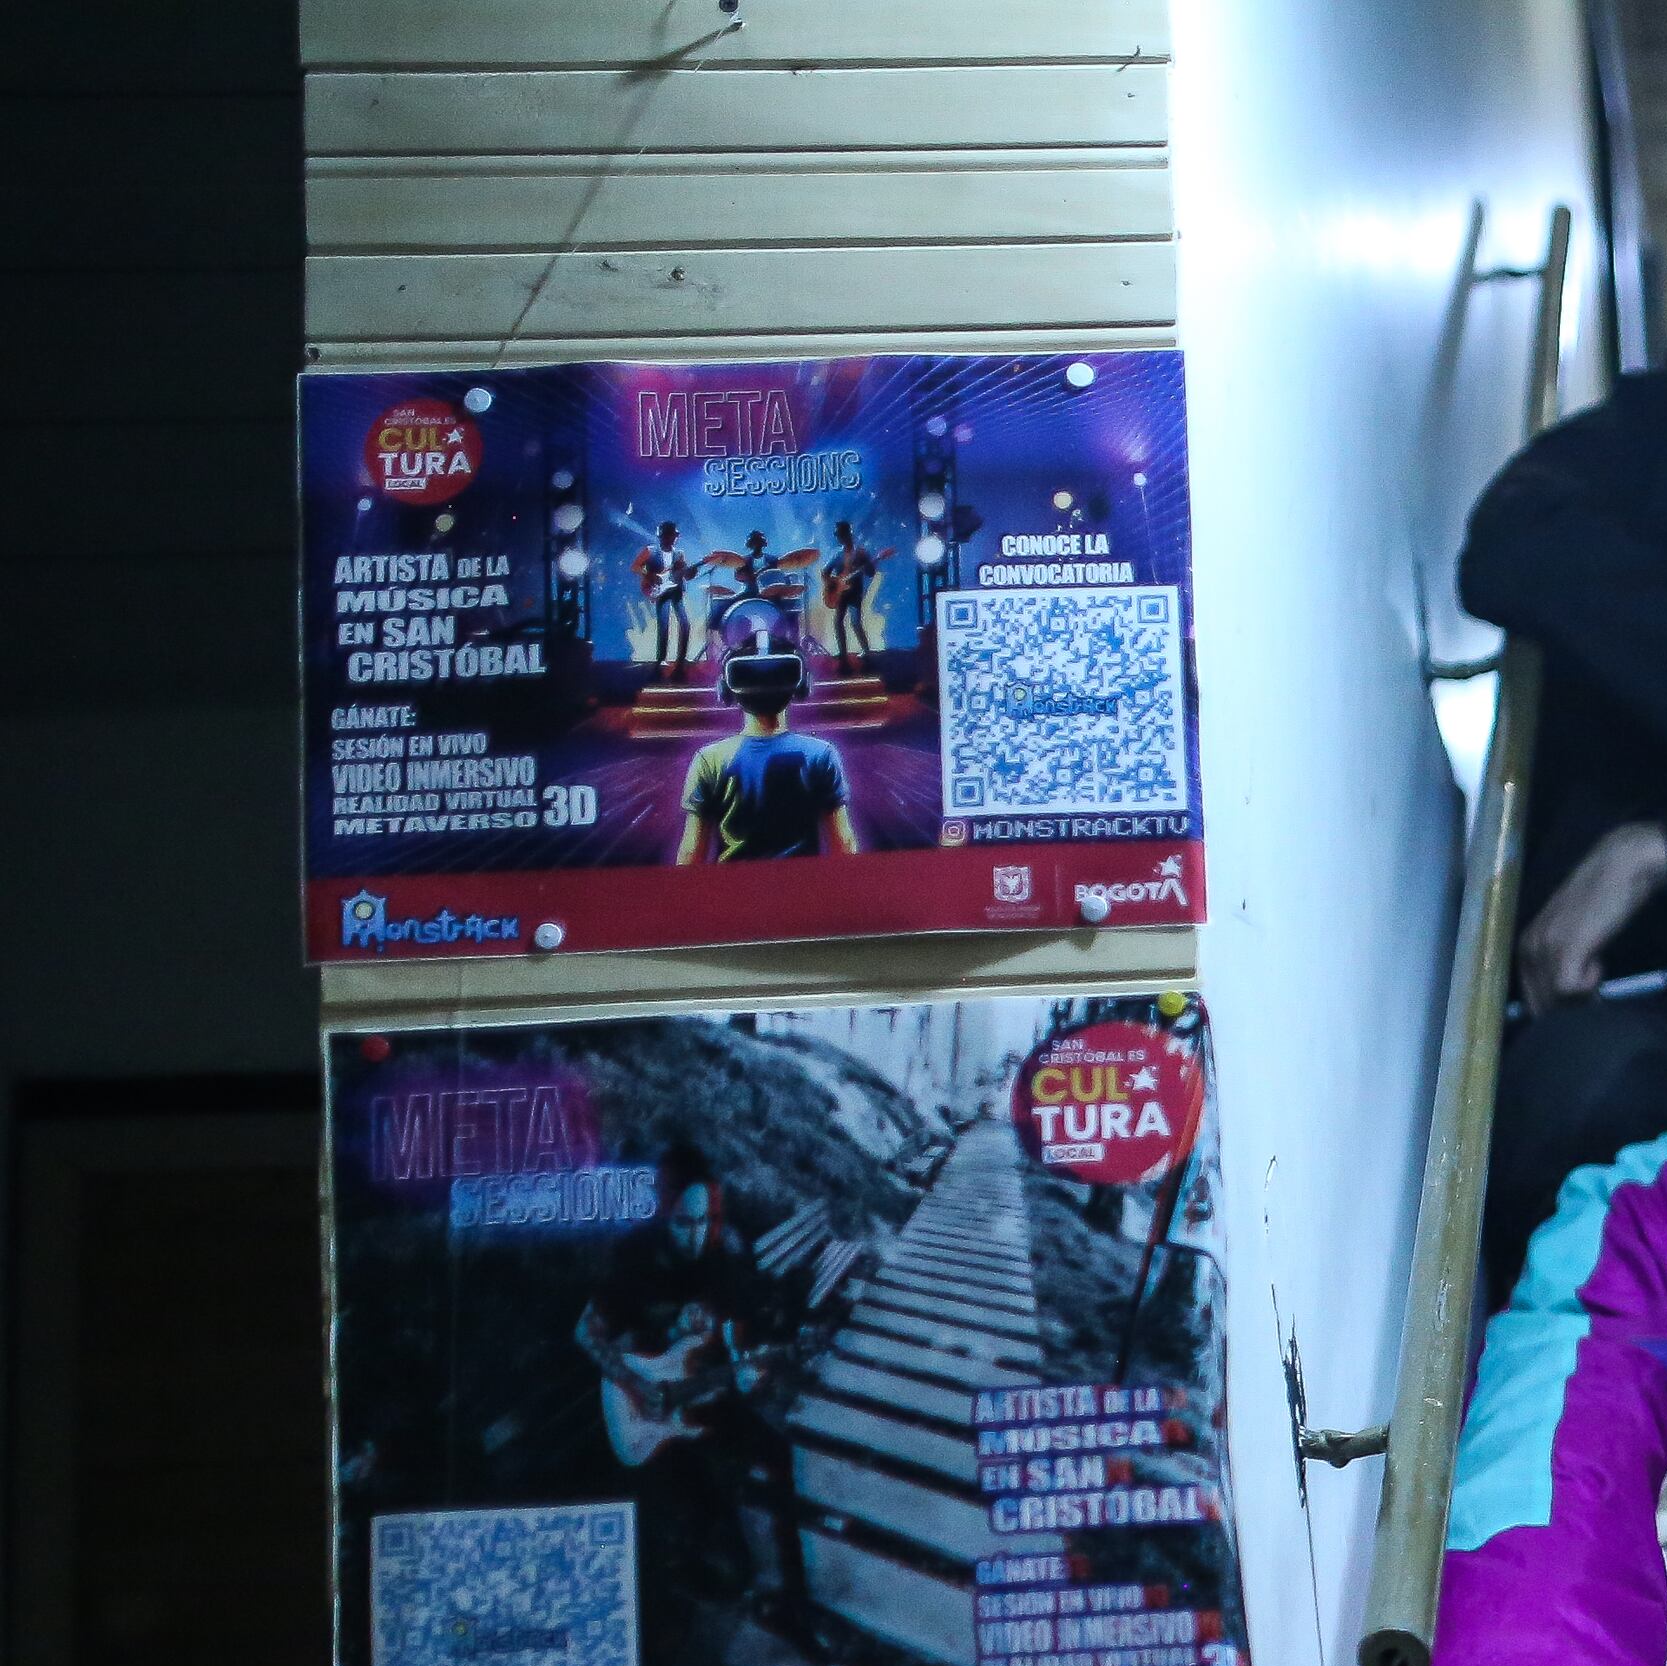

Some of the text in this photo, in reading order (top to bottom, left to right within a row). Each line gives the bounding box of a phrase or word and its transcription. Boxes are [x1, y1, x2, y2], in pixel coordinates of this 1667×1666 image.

[378, 426, 443, 452] CUL
[638, 390, 799, 458] META
[377, 450, 472, 476] TURA
[703, 450, 861, 497] SESSIONS
[1001, 533, 1110, 557] CONOCE LA
[335, 553, 510, 584] ARTISTA DE LA
[978, 562, 1135, 586] CONVOCATORIA
[337, 584, 509, 613] MÚSICA
[339, 615, 456, 648] EN SAN
[347, 641, 547, 682] CRISTÓBAL
[408, 735, 434, 757] EN
[437, 732, 489, 756] VIVO
[332, 756, 536, 794] VIDEO INMERSIVO
[333, 789, 537, 815] REALIDAD VIRTUAL
[543, 785, 597, 827] 3D
[333, 811, 538, 836] METAVERSO
[1051, 1039, 1084, 1050] SAN
[1030, 1065, 1131, 1102] CUL
[371, 1086, 574, 1181] META
[1030, 1101, 1171, 1141] TURA
[450, 1166, 657, 1227] SESSIONS
[1026, 1455, 1105, 1491] SAN
